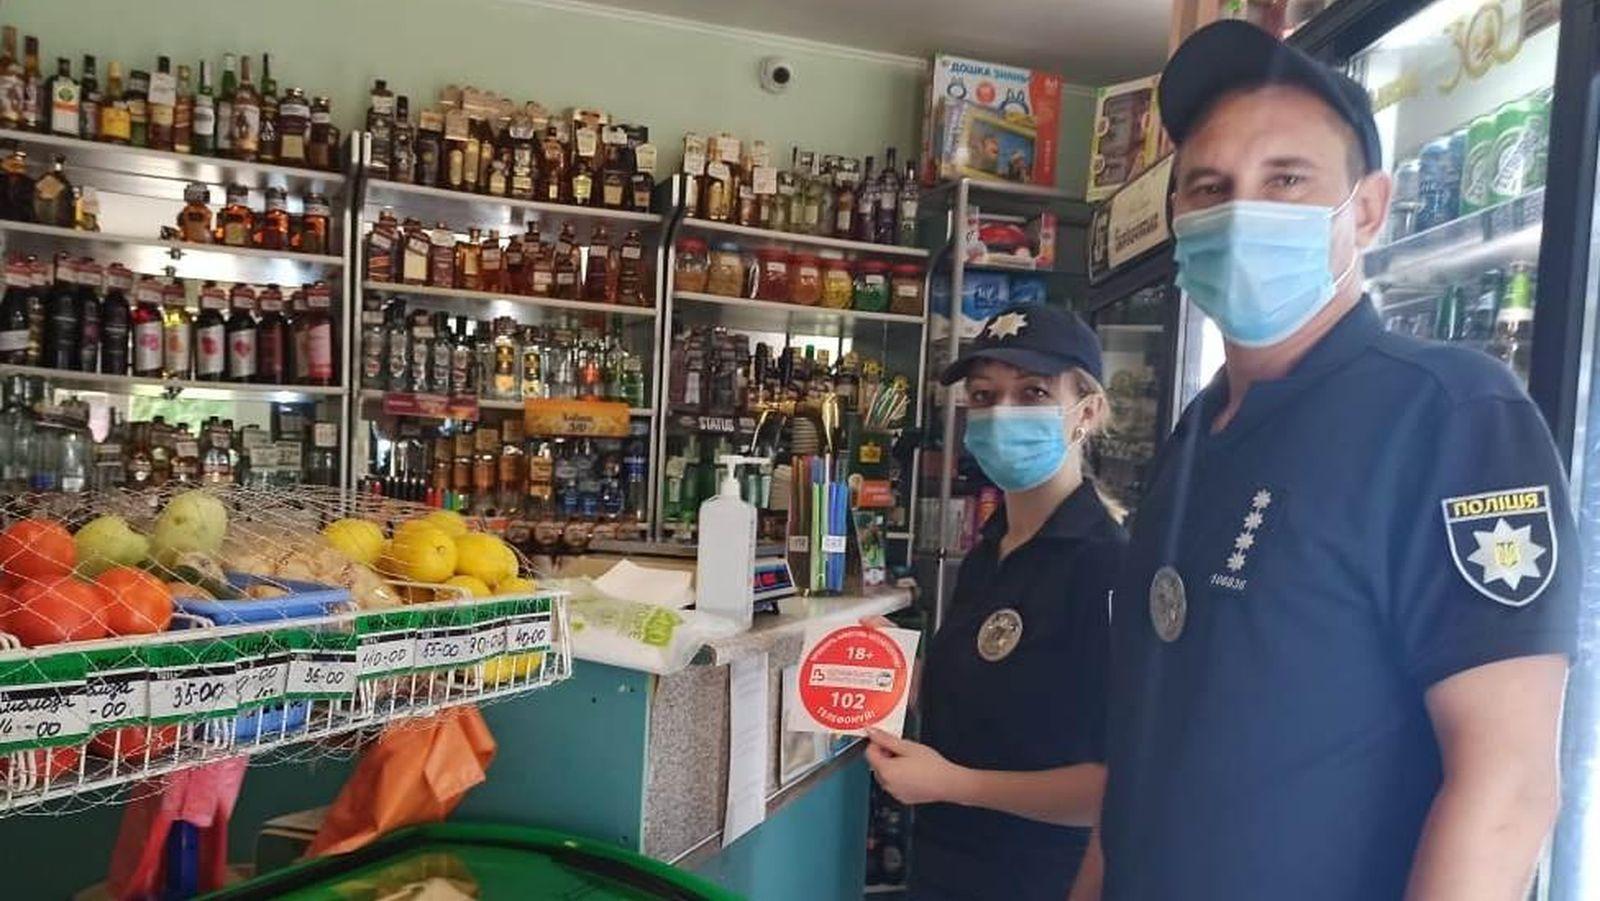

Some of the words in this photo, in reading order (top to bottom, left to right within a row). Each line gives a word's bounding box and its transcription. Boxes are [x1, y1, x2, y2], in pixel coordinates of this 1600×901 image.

[951, 61, 991, 76] ДОШКА
[698, 415, 735, 432] STATUS
[1453, 492, 1539, 517] ПОЛІЦІЯ
[845, 646, 874, 660] 18+
[831, 692, 866, 709] 102
